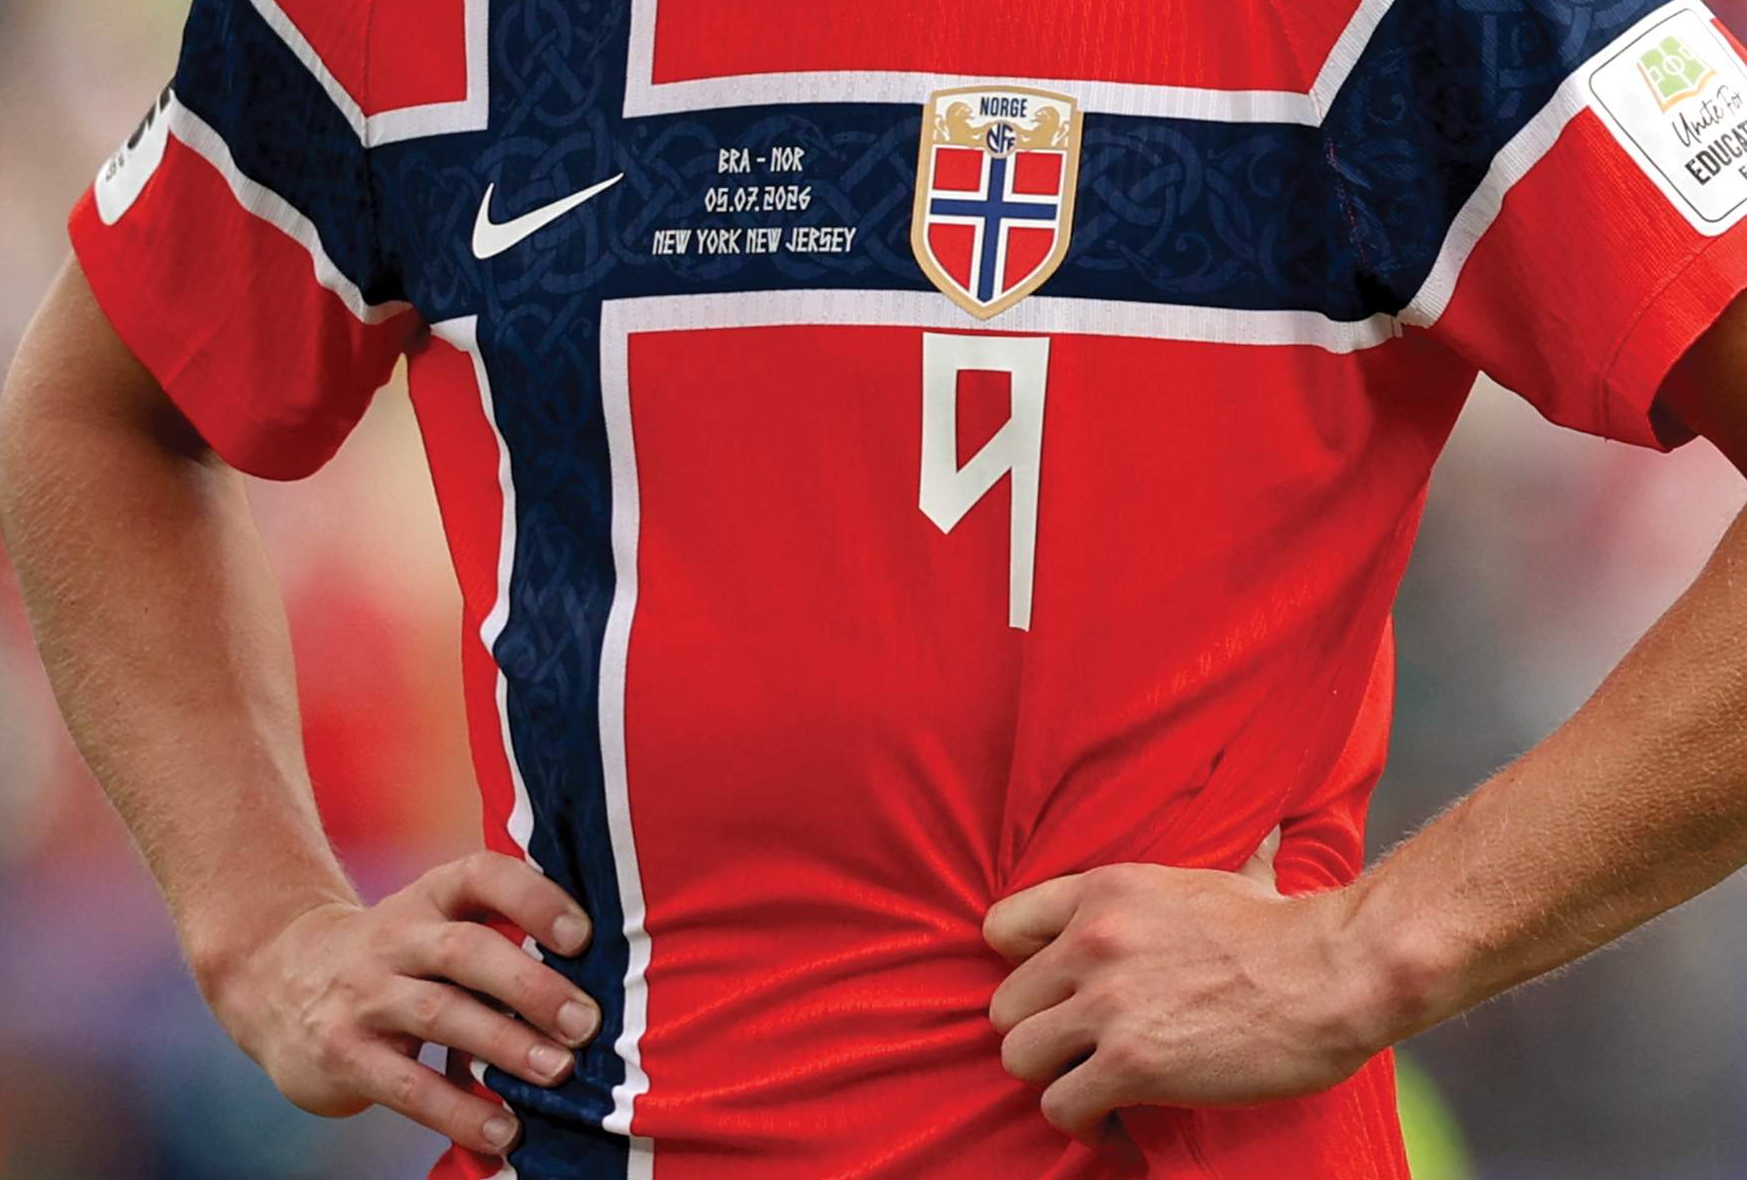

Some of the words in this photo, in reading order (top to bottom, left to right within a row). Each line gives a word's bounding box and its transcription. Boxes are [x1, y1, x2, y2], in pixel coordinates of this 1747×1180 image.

[979, 97, 1028, 118] NORGE
[1671, 99, 1724, 147] Unite
[718, 147, 751, 173] BRA
[770, 147, 805, 172] NOR
[704, 186, 812, 212] 05.07.2026
[652, 229, 692, 254] NEW
[696, 228, 742, 254] YORK
[745, 227, 782, 253] NEW
[785, 227, 857, 253] JERSEY
[918, 331, 1051, 632] 9
